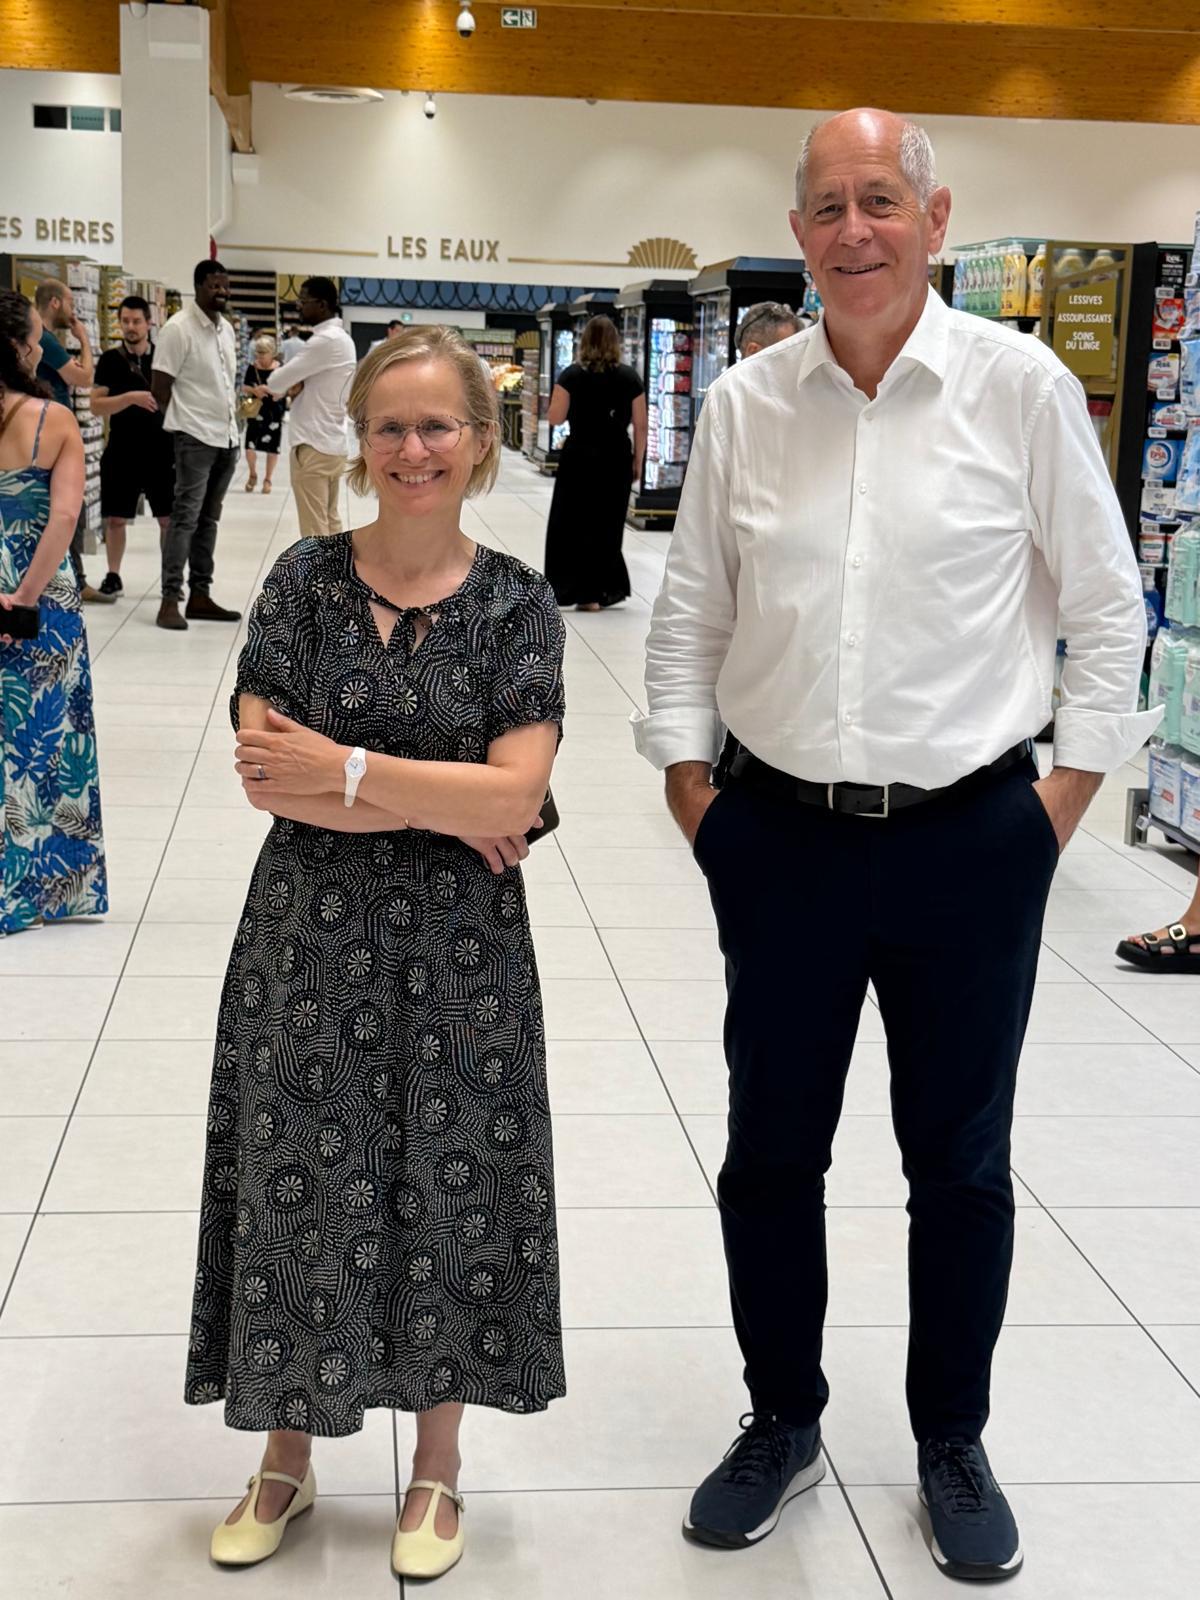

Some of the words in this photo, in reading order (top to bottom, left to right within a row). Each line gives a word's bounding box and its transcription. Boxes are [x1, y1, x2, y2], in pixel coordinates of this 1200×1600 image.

[35, 217, 115, 244] BIÈRES
[387, 235, 427, 258] LES
[440, 238, 499, 262] EAUX
[1068, 294, 1103, 305] LESSIVES
[1057, 312, 1112, 323] ASSOUPLISSANTS
[1072, 331, 1095, 341] SOINS
[1065, 340, 1077, 350] DU
[1078, 340, 1100, 351] LINGE
